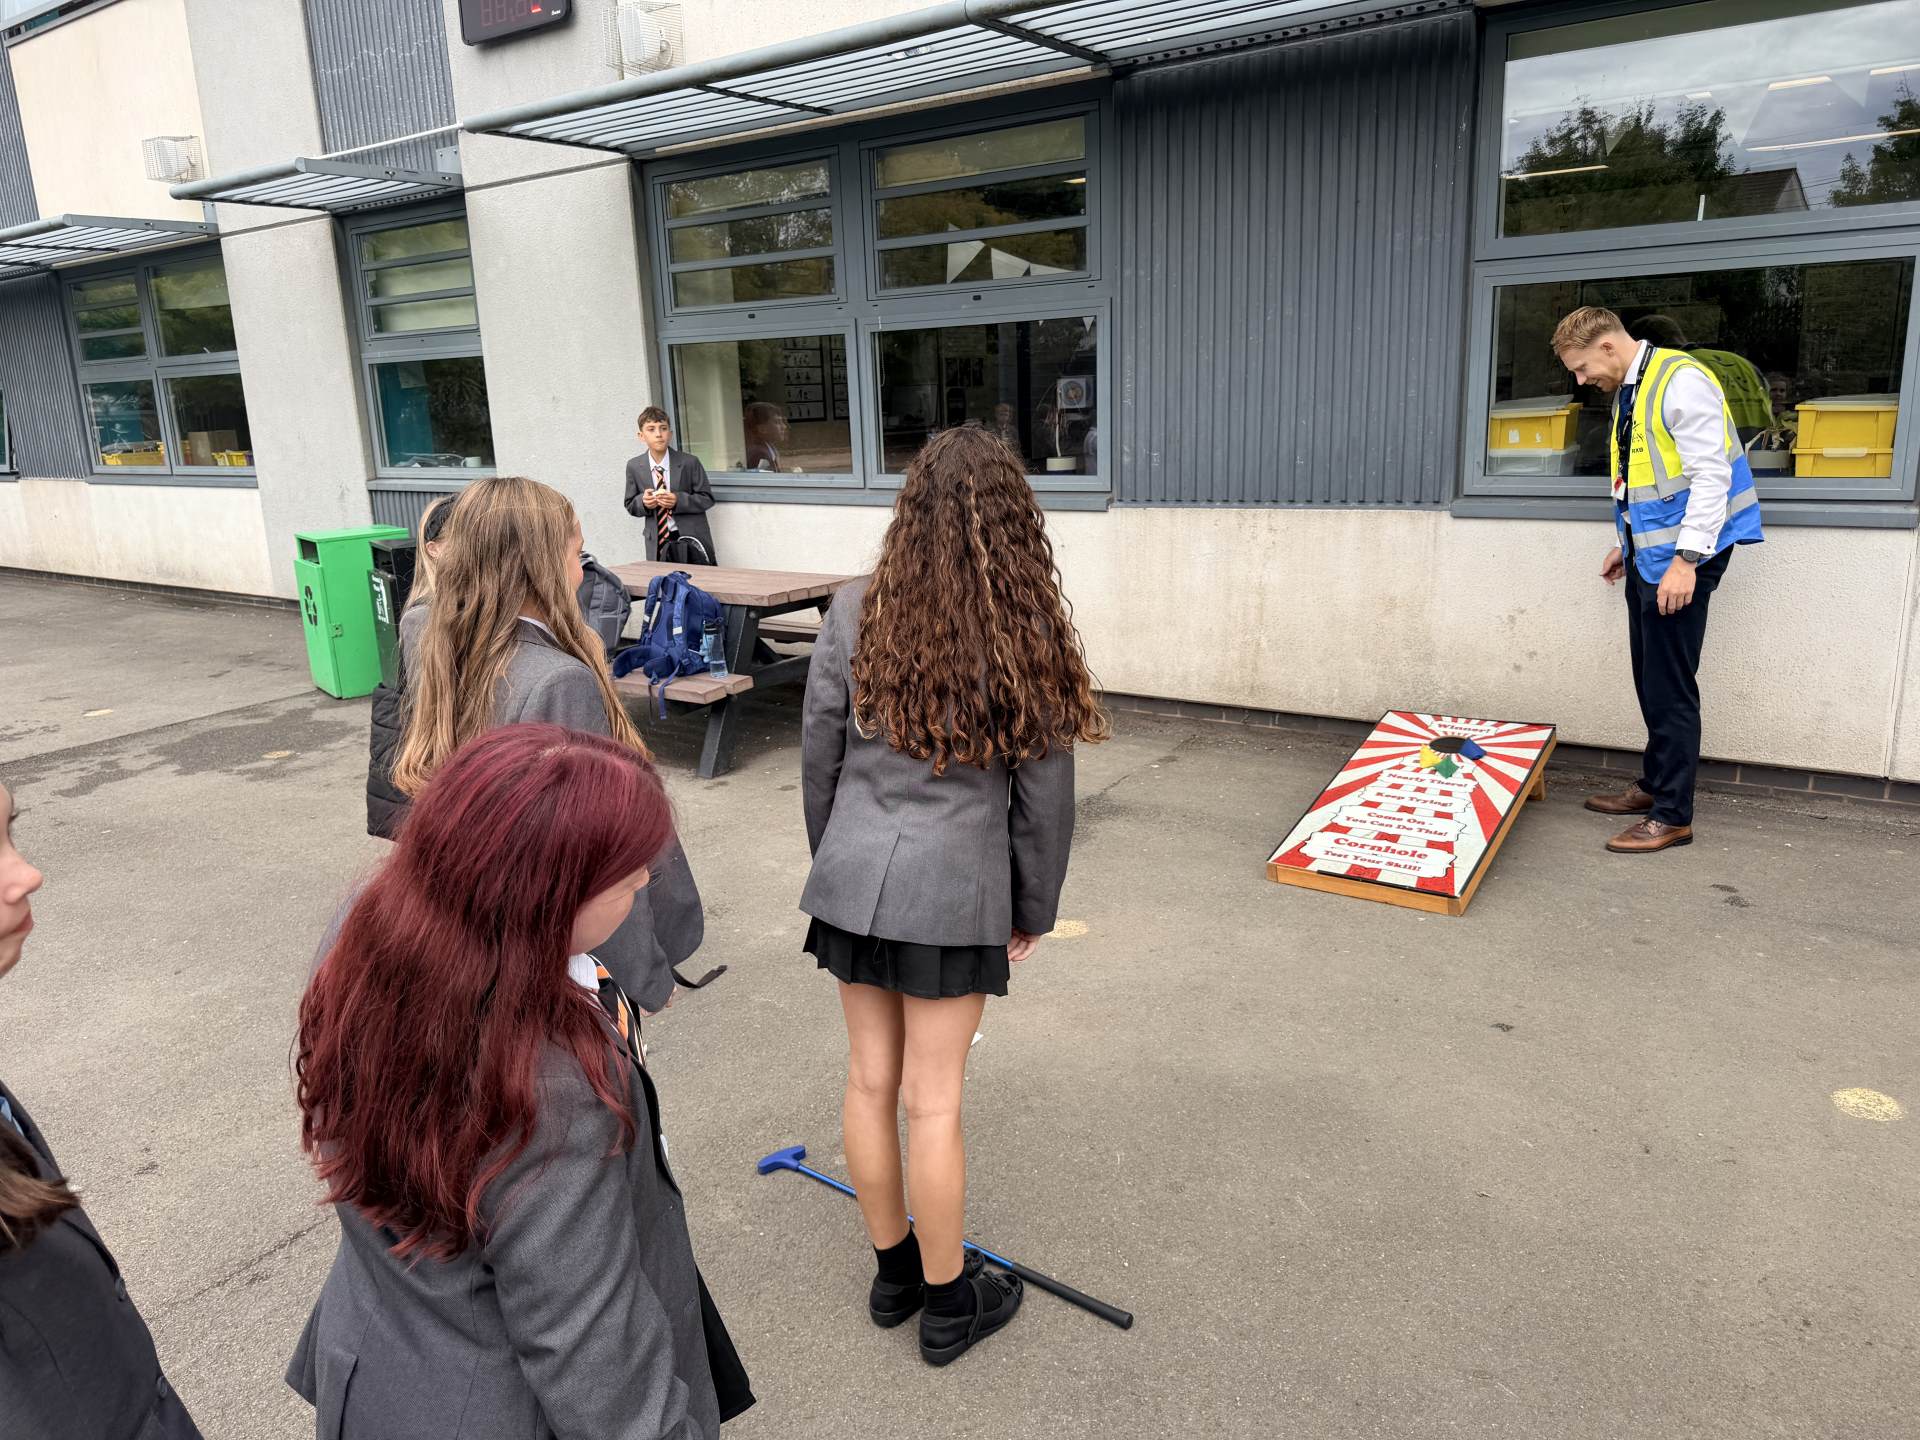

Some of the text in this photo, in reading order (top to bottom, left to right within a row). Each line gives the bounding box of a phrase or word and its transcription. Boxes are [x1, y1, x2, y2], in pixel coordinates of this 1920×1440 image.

[1437, 723, 1491, 732] Winner!
[1387, 773, 1468, 788] Nearly There!
[1375, 791, 1454, 808] Keep Trying!
[1344, 815, 1448, 837] You Can Do This!
[1367, 811, 1403, 822] Come
[1407, 817, 1426, 825] On
[1333, 837, 1429, 860] Cornhole
[1323, 850, 1422, 872] Test Your Skill!
